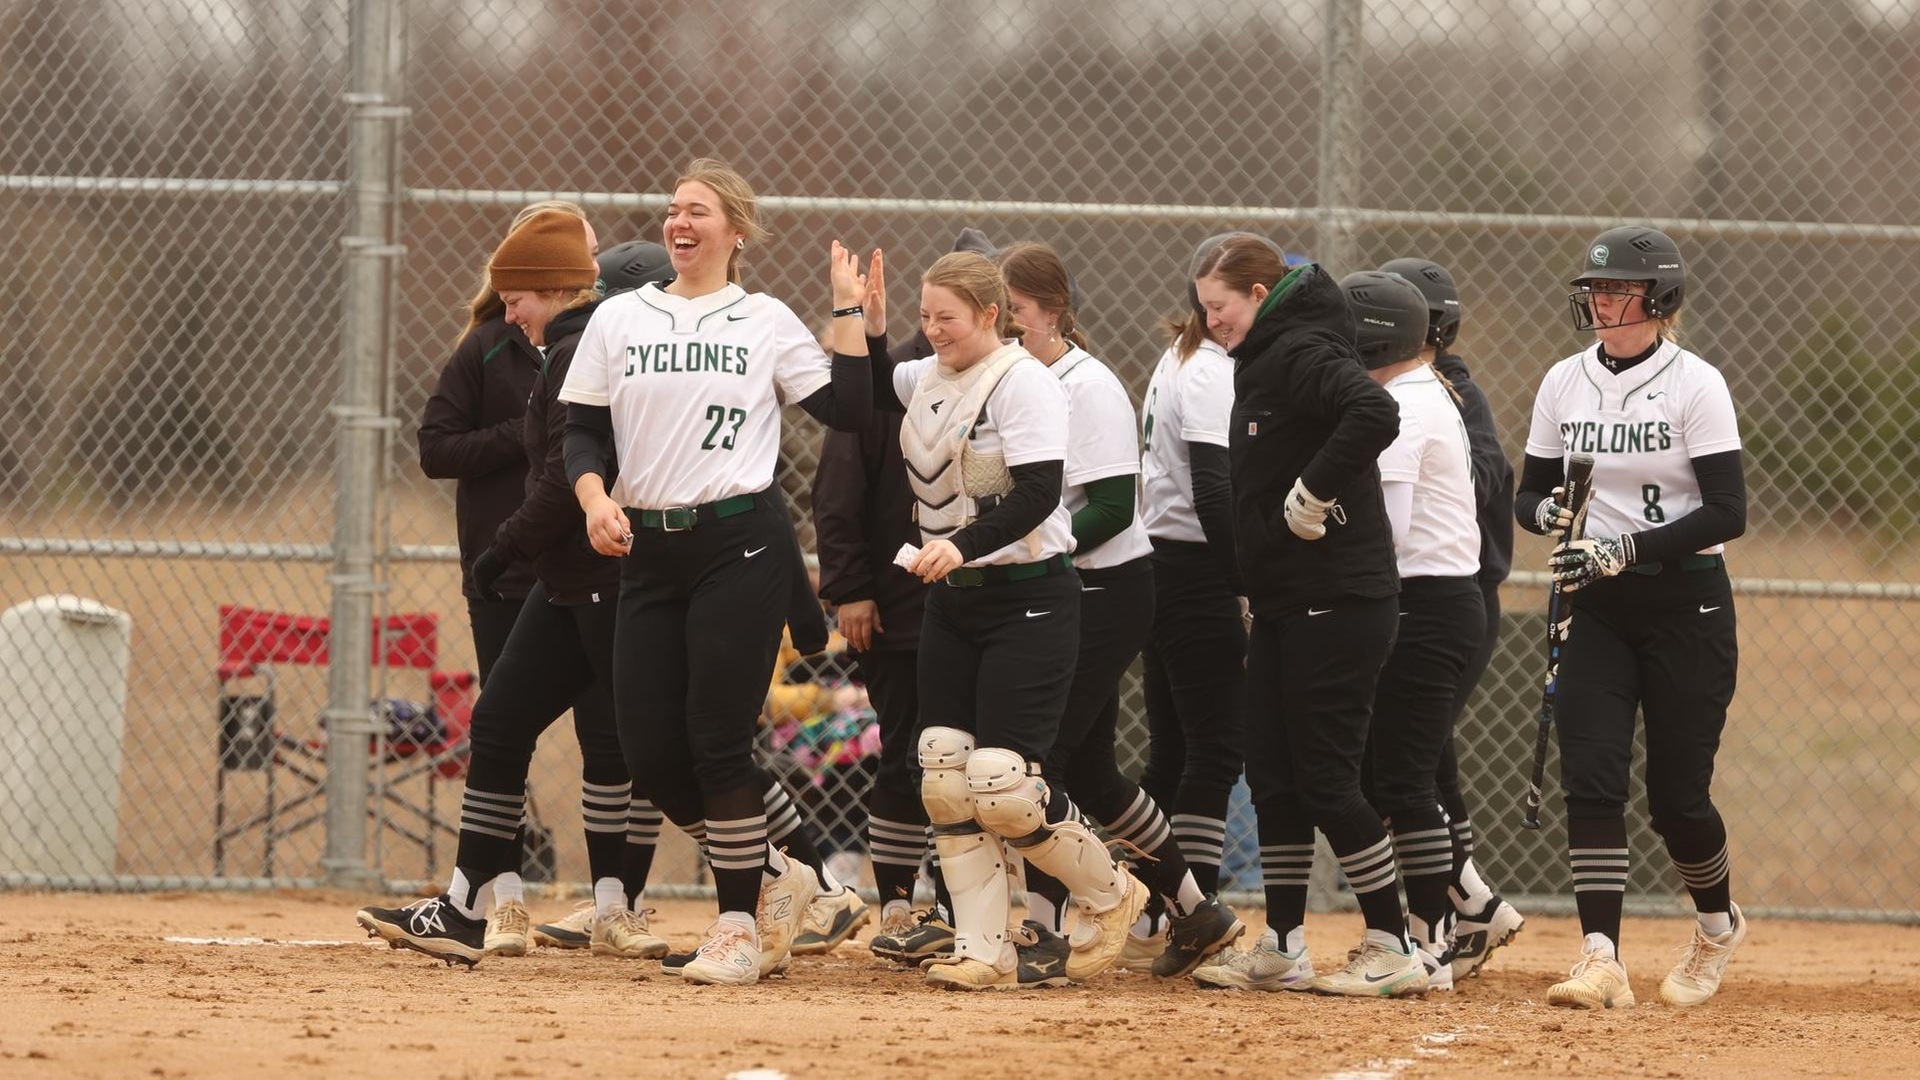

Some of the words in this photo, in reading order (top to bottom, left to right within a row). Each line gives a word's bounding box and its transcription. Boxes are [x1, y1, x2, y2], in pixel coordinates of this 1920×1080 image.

[624, 342, 749, 377] CYCLONES
[701, 404, 747, 451] 23
[1559, 420, 1672, 454] CYCLONES
[1641, 483, 1665, 524] 8
